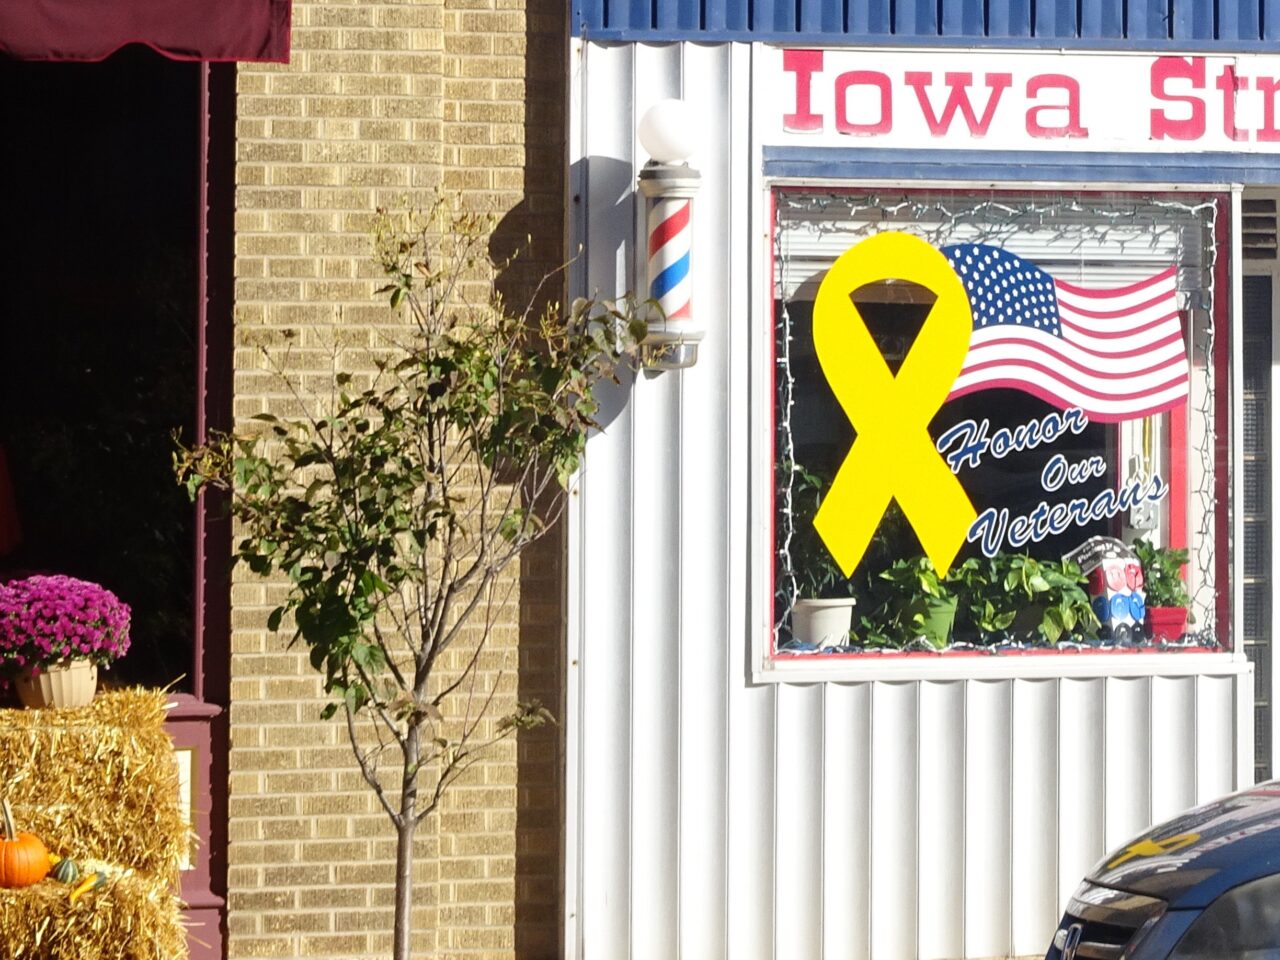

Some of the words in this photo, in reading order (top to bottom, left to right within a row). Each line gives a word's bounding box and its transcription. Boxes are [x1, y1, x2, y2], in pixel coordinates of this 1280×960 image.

[783, 49, 1089, 140] Iowa
[936, 406, 1089, 474] Honor
[1041, 453, 1107, 492] Our
[967, 474, 1169, 558] Veterans
